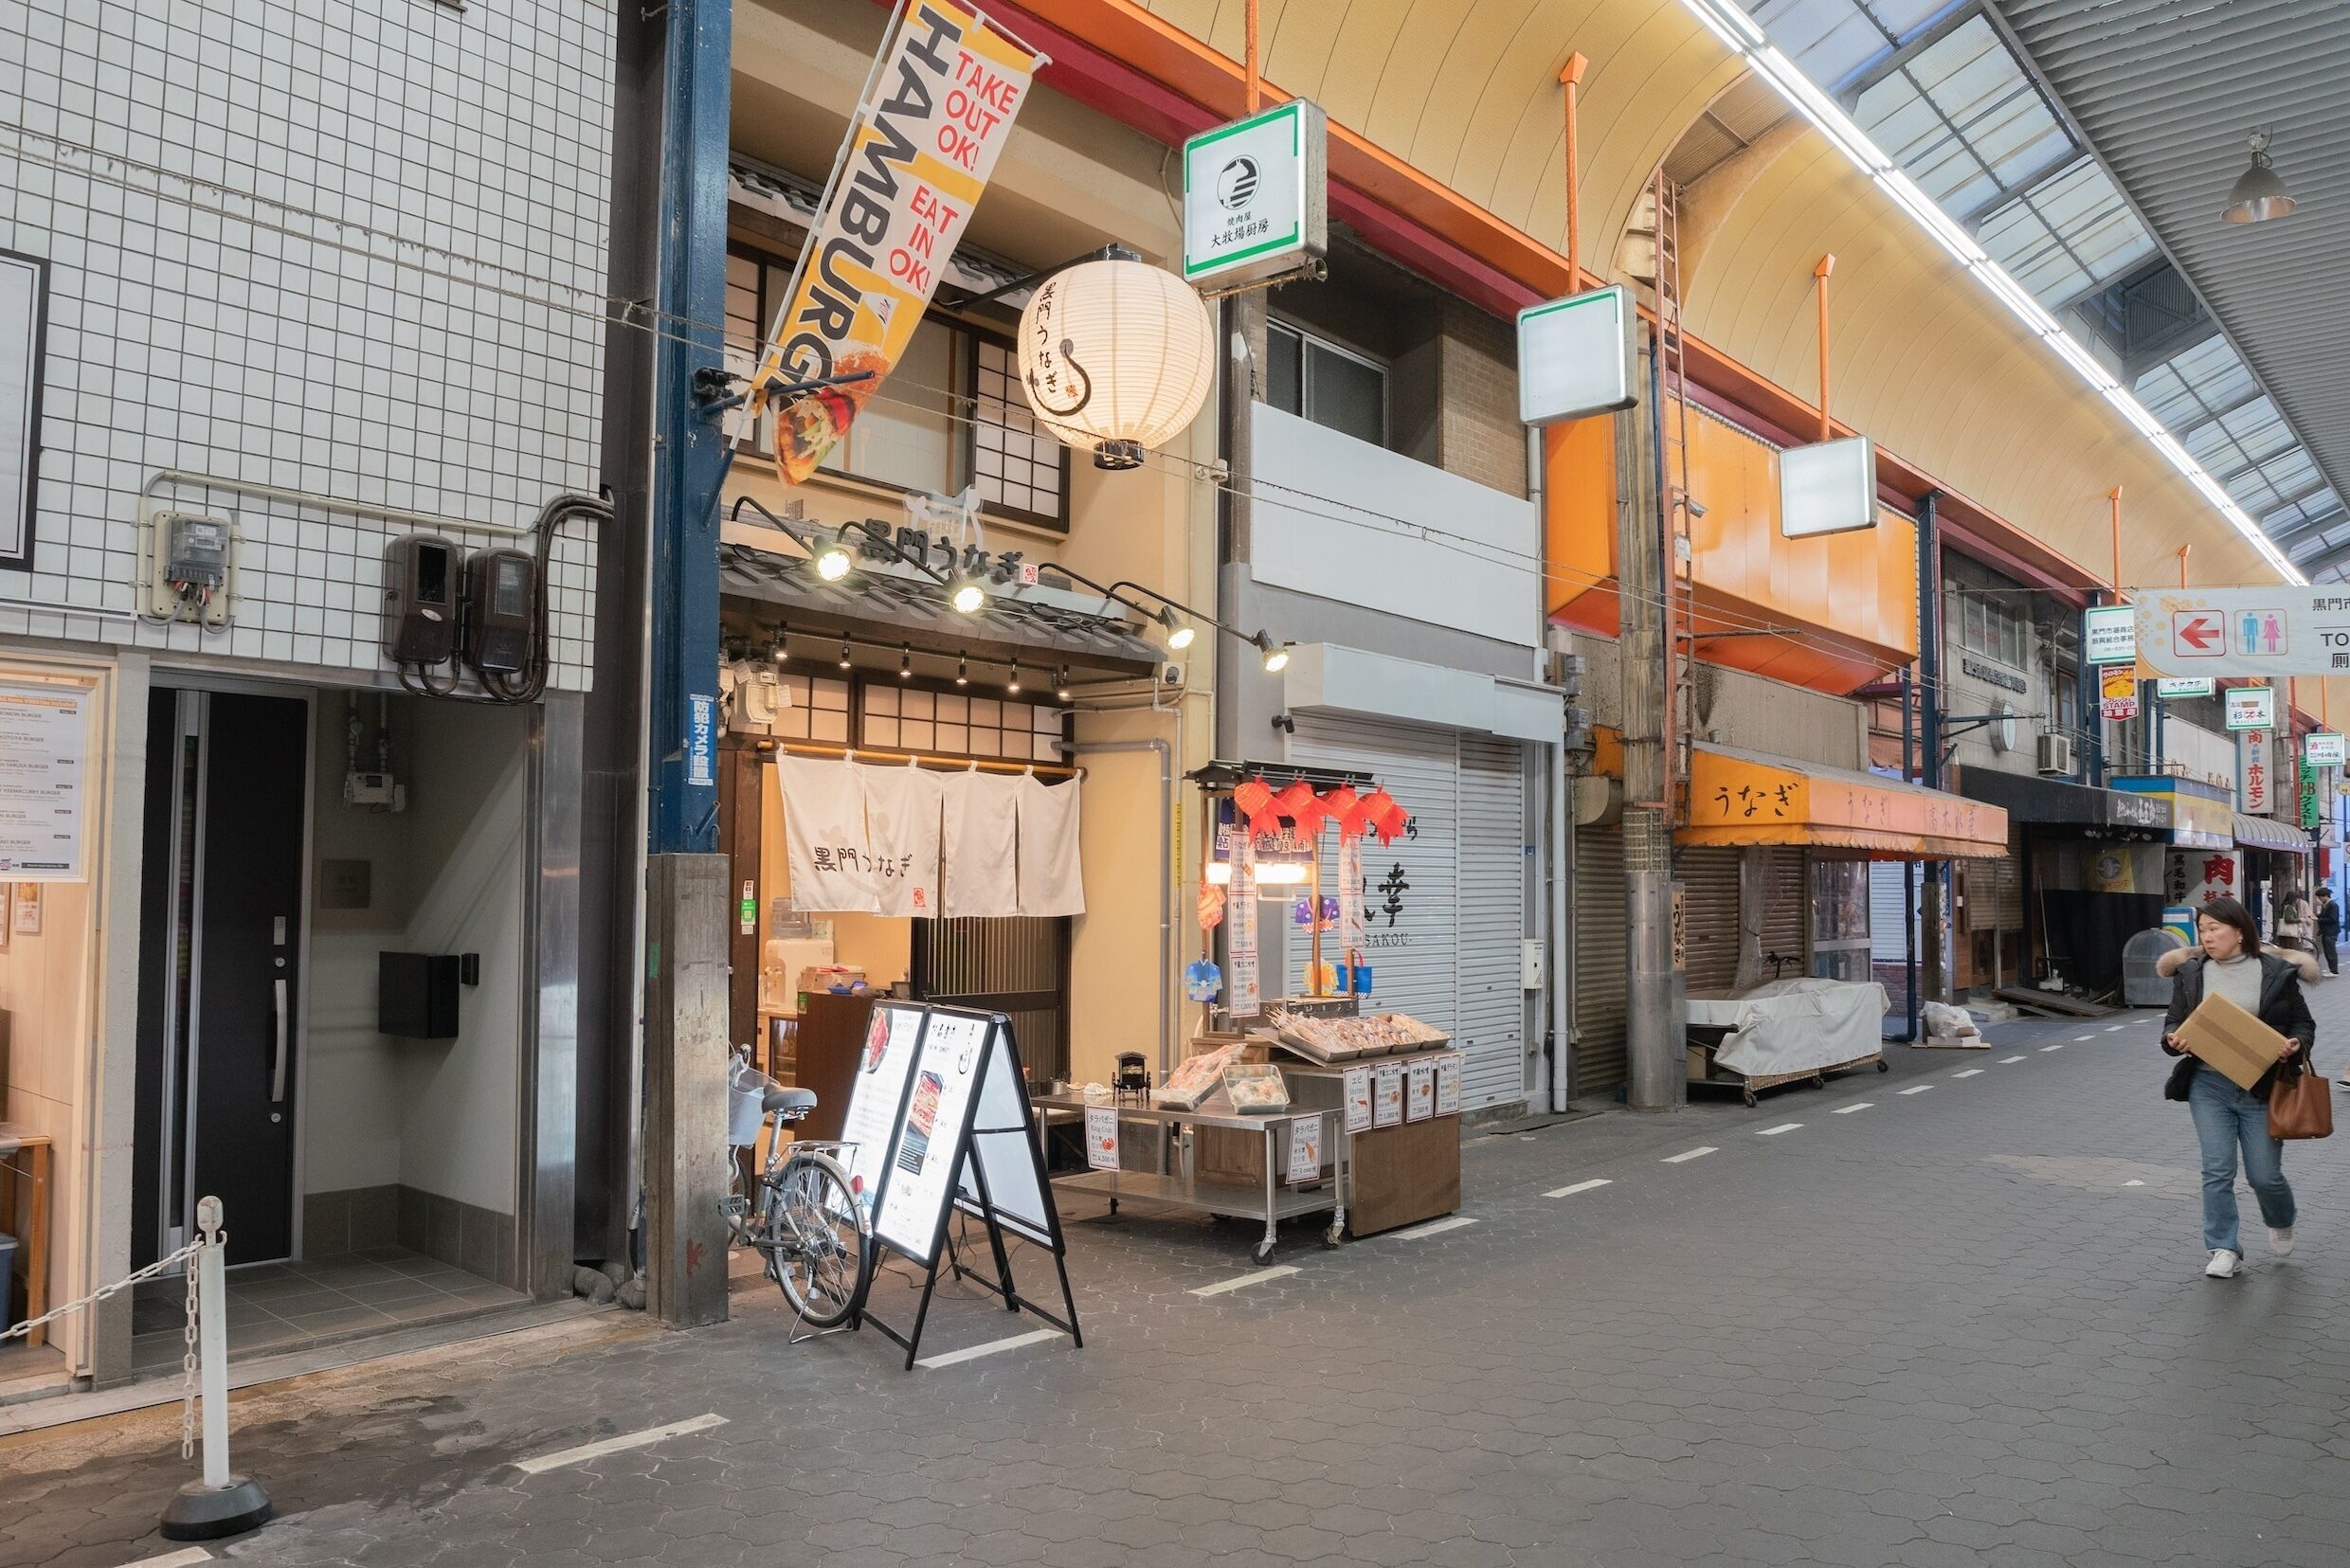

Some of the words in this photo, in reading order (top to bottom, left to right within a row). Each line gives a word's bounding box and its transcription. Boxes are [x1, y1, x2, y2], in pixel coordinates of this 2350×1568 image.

[956, 49, 1020, 116] TAKE
[945, 89, 1001, 139] OUT
[936, 124, 981, 172] OK!
[909, 184, 959, 235] EAT
[908, 221, 936, 261] IN
[1210, 218, 1269, 248] 大牧場厨房
[889, 247, 931, 296] OK!
[1036, 281, 1058, 394] 黒門うなぎ
[858, 518, 1024, 586] 黒門うなぎ
[2321, 633, 2350, 646] TO
[693, 700, 711, 778] 防犯カメラ設置
[1714, 782, 1799, 818] うなぎ
[1848, 790, 1889, 826] うなぎ
[814, 846, 913, 877] 黒門うなぎ
[2174, 854, 2186, 903] 黒毛和牛
[2203, 854, 2234, 885] 肉
[1351, 1074, 1363, 1085] エビ
[1090, 1113, 1113, 1125] タラバガニ
[1295, 1123, 1318, 1136] タラバガニ
